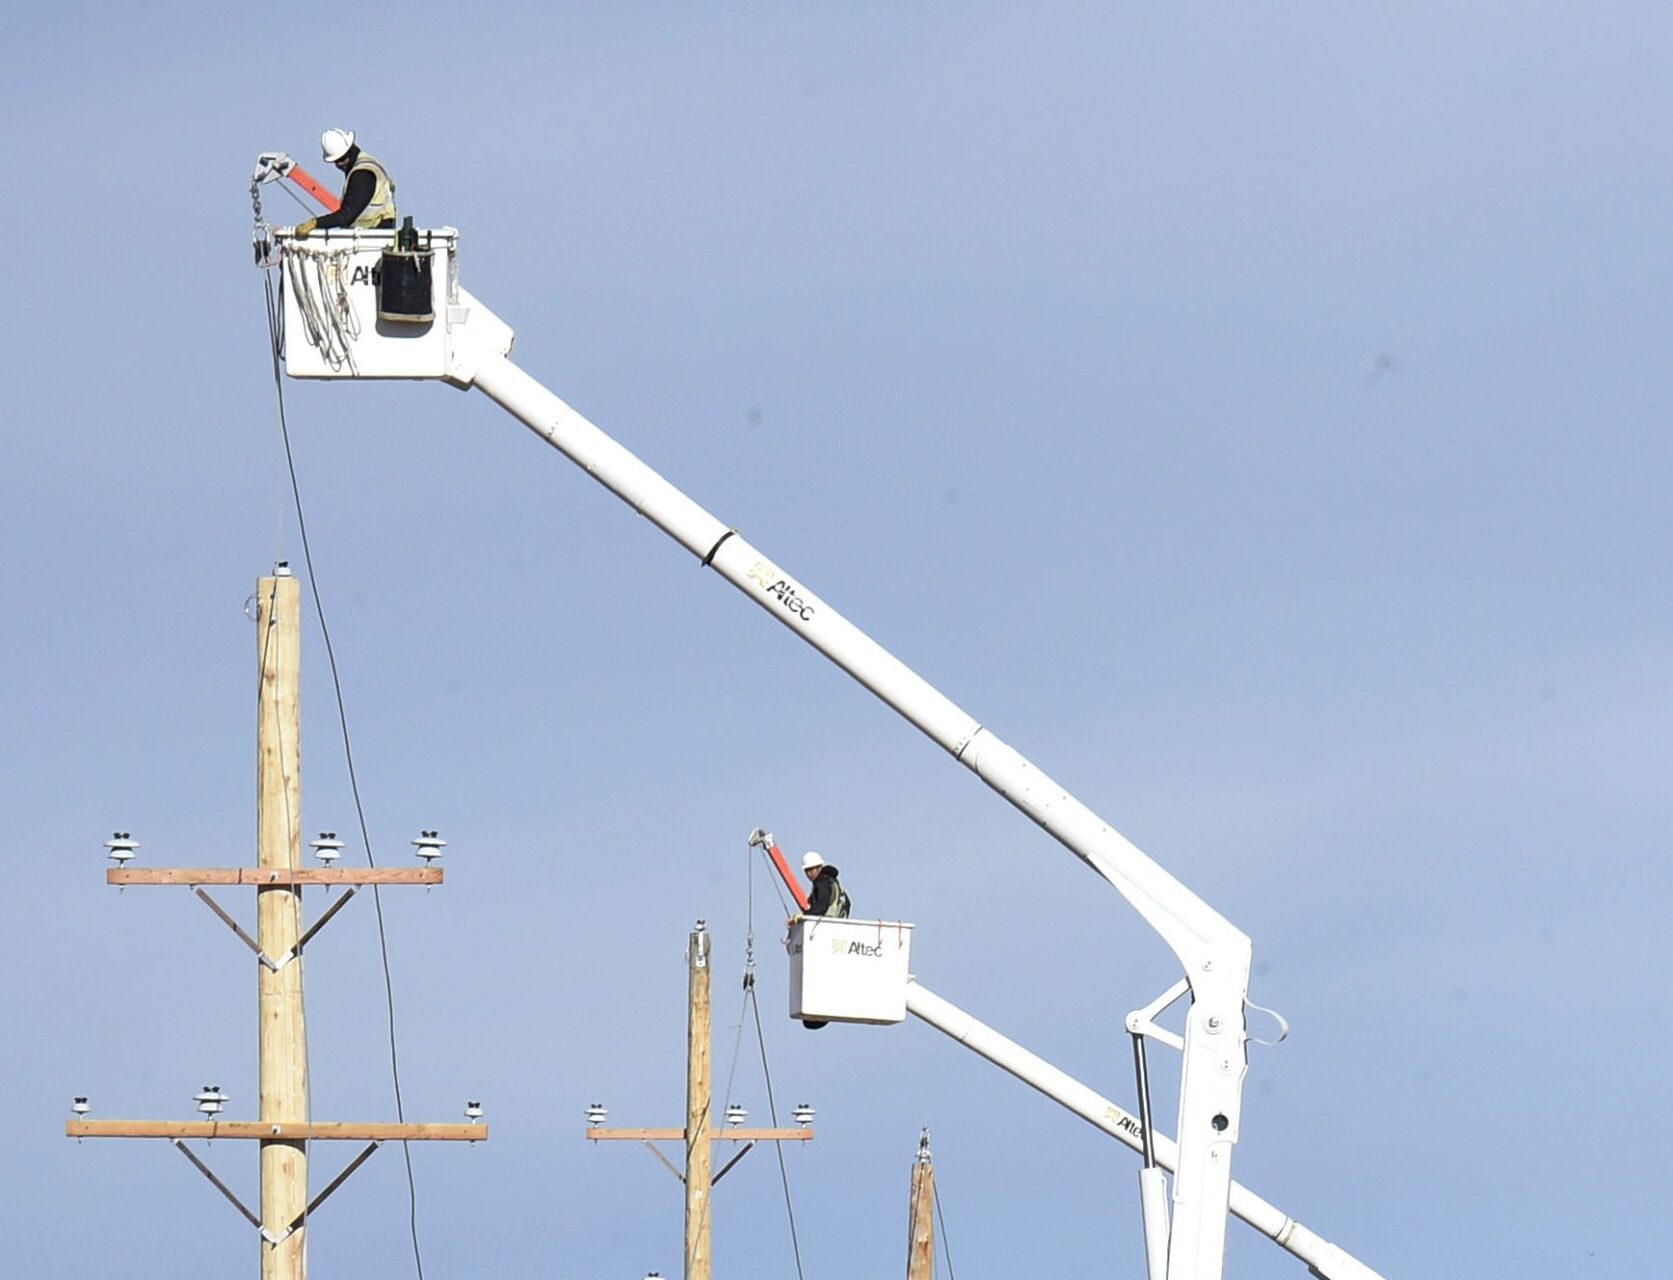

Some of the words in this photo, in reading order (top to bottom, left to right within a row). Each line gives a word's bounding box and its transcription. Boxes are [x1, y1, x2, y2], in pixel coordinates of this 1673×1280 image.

[350, 265, 381, 286] Alt
[766, 580, 815, 621] Altec
[847, 941, 884, 957] Altec
[1117, 1116, 1144, 1141] Alte
